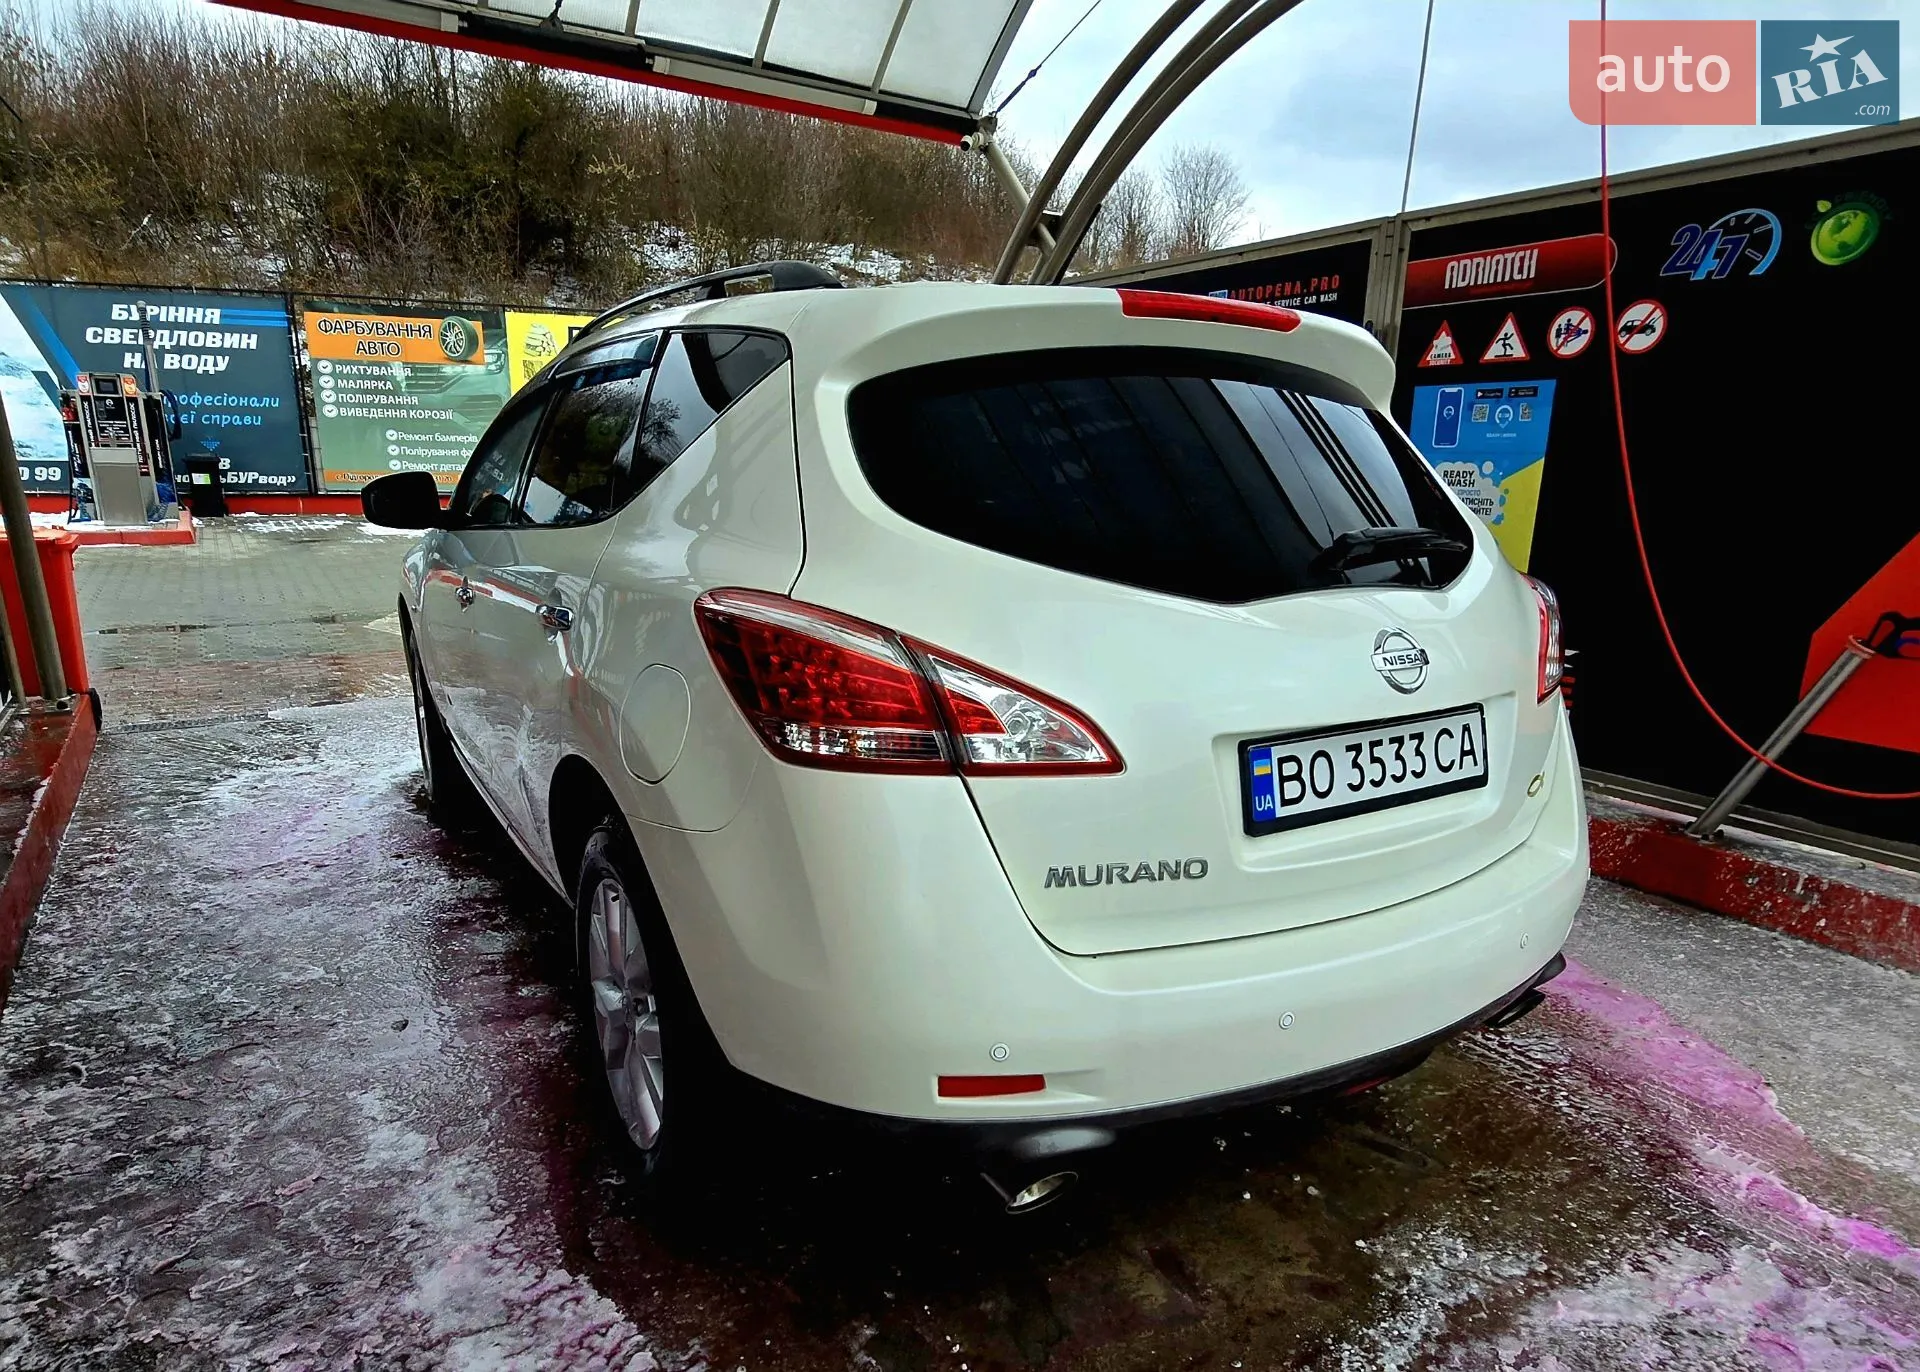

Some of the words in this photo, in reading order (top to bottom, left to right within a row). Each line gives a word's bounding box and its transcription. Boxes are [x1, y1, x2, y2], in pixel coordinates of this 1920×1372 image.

[1304, 294, 1317, 304] CAR
[1320, 292, 1338, 303] WASH
[317, 318, 434, 339] ФАРБУВАННЯ
[355, 340, 402, 357] АВТО
[163, 353, 230, 375] ВОДУ
[335, 364, 412, 377] РИХТУВАННЯ
[337, 379, 394, 391] МАЛЯРКА
[338, 393, 419, 406] ПОЛІРУВАННЯ
[340, 407, 407, 420] ВИВЕДЕННЯ
[409, 408, 453, 420] КОРОЗІЇ
[201, 413, 262, 428] справи
[398, 431, 434, 442] Ремонт
[434, 432, 478, 444] бамперів
[400, 446, 459, 458] Полірування
[402, 460, 438, 471] Ремонт
[34, 466, 62, 482] 99
[1442, 470, 1475, 479] READY
[1445, 479, 1475, 488] WASH
[1278, 748, 1335, 808] BO
[1346, 730, 1428, 793] 3533
[1433, 722, 1479, 774] CA
[1254, 793, 1274, 812] UA
[1043, 855, 1209, 889] MURANO
